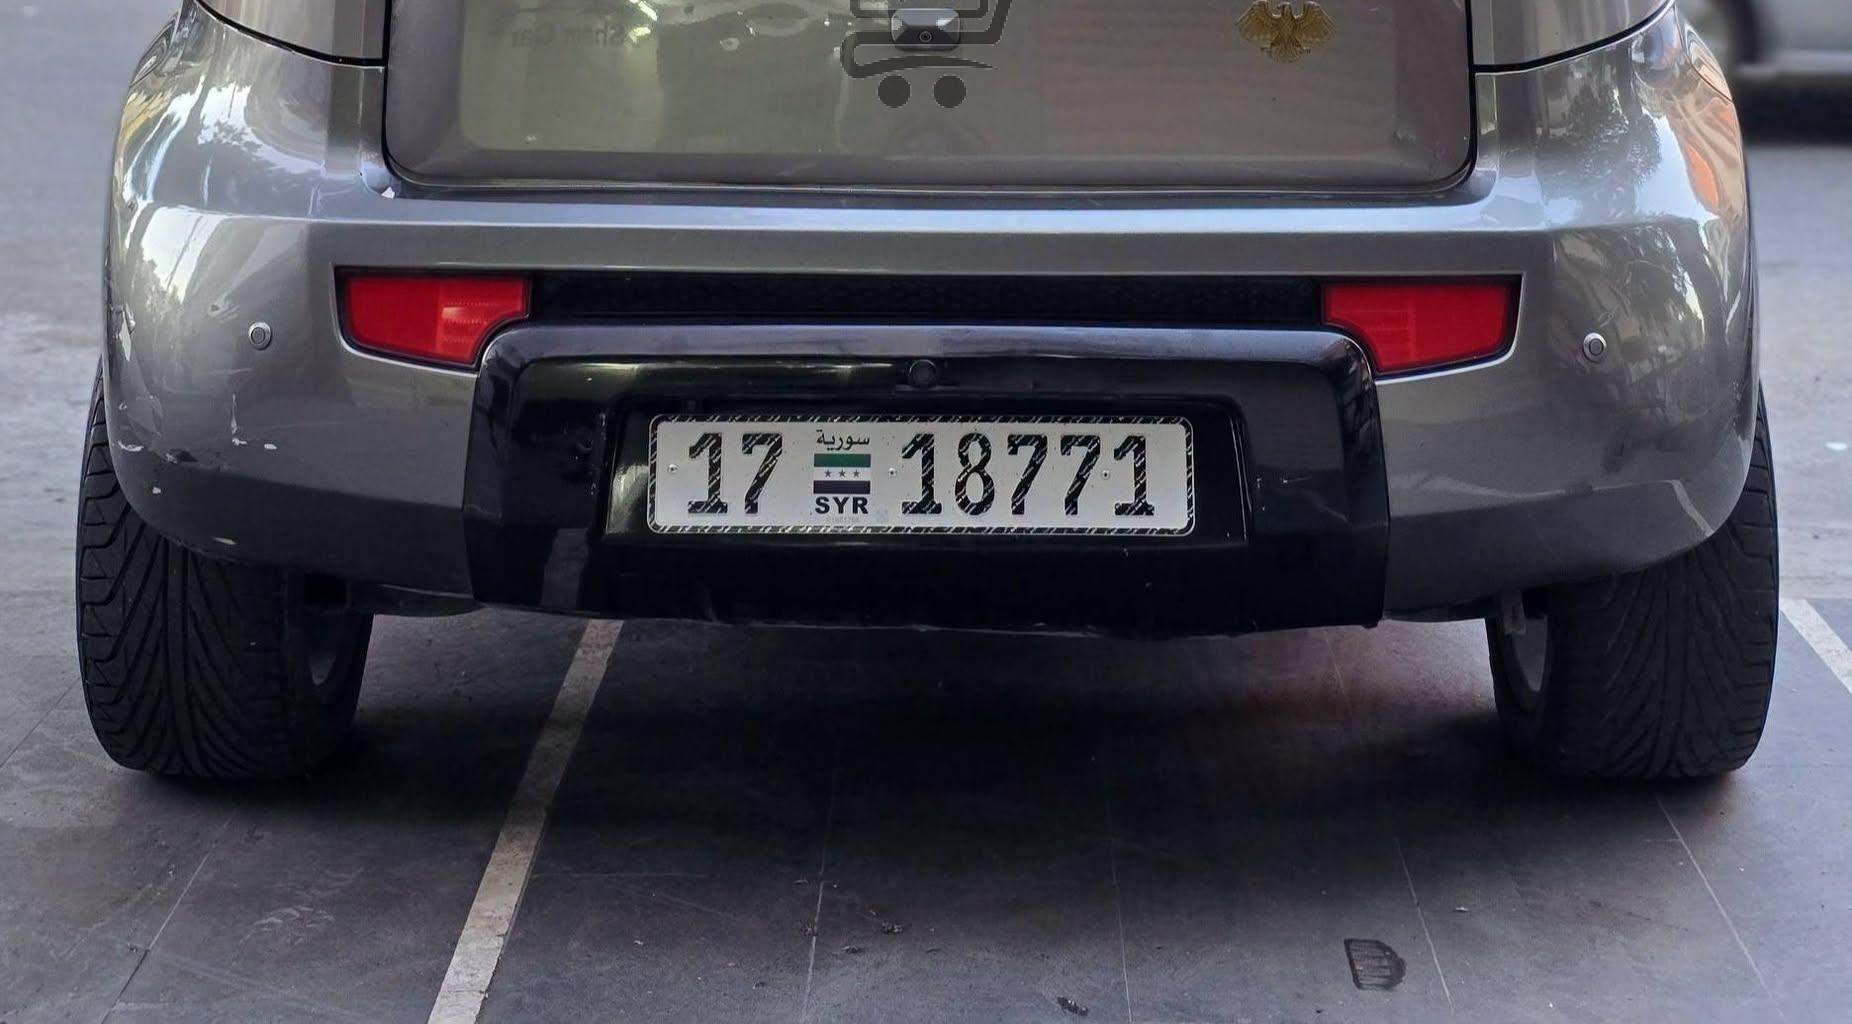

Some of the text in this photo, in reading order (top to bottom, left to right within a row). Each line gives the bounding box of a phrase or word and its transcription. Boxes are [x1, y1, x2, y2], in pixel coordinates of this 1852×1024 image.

[815, 428, 871, 451] سورية
[686, 432, 784, 516] 17
[900, 432, 1155, 517] 18771
[814, 496, 869, 515] SYR
